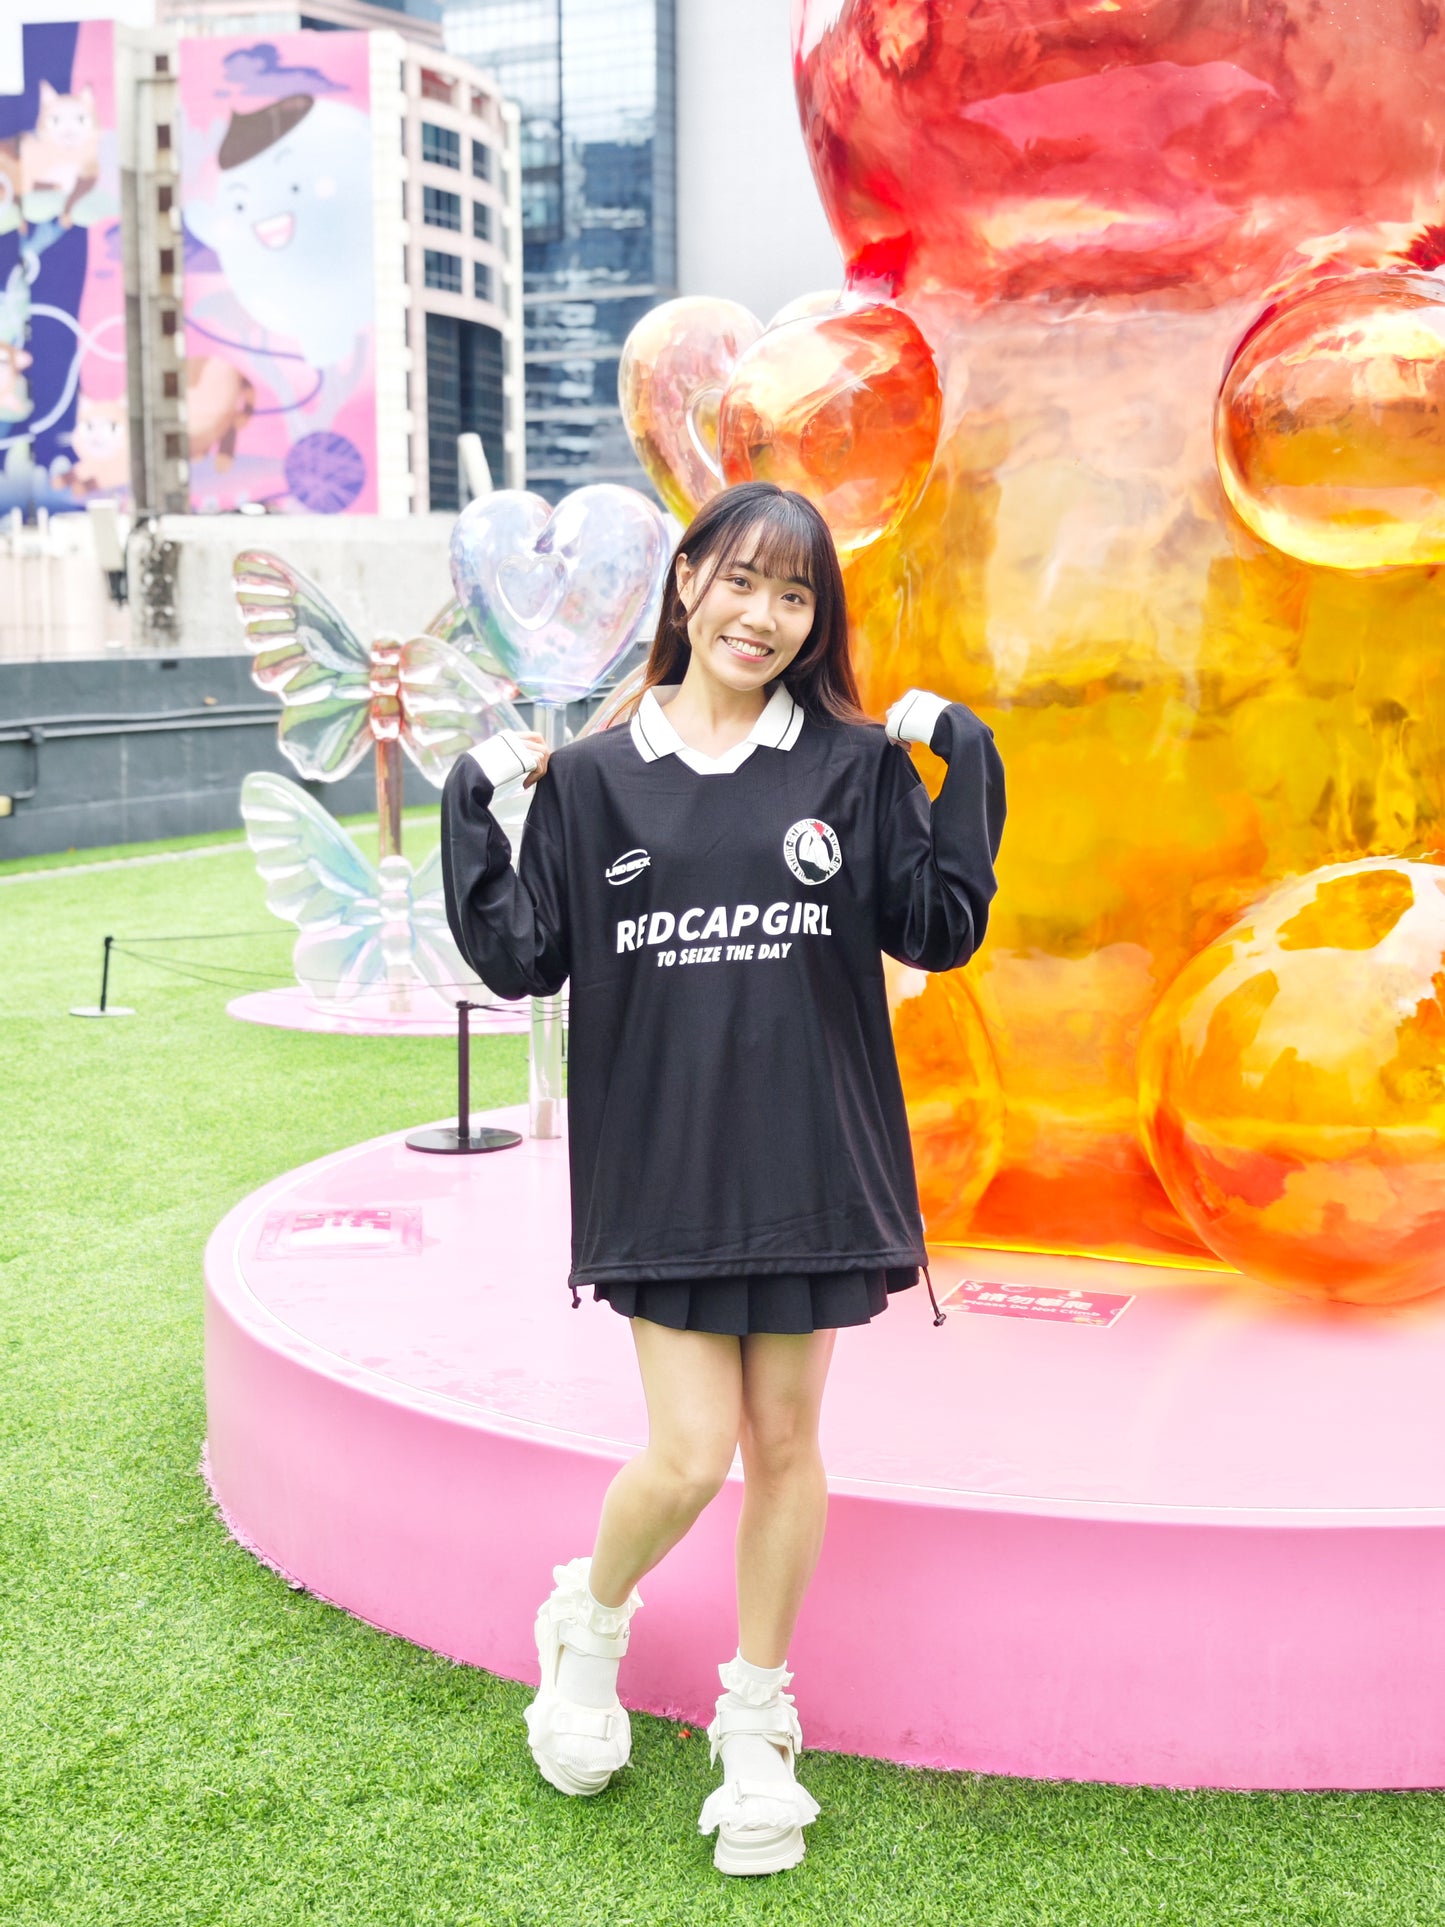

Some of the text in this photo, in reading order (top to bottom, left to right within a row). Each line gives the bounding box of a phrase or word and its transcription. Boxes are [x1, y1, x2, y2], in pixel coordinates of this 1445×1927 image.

[616, 901, 832, 953] REDCAPGIRL
[657, 942, 792, 967] TO SEIZE THE DAY
[963, 1300, 1006, 1308] Please
[1031, 1305, 1056, 1313] Not
[1060, 1308, 1101, 1316] Climb
